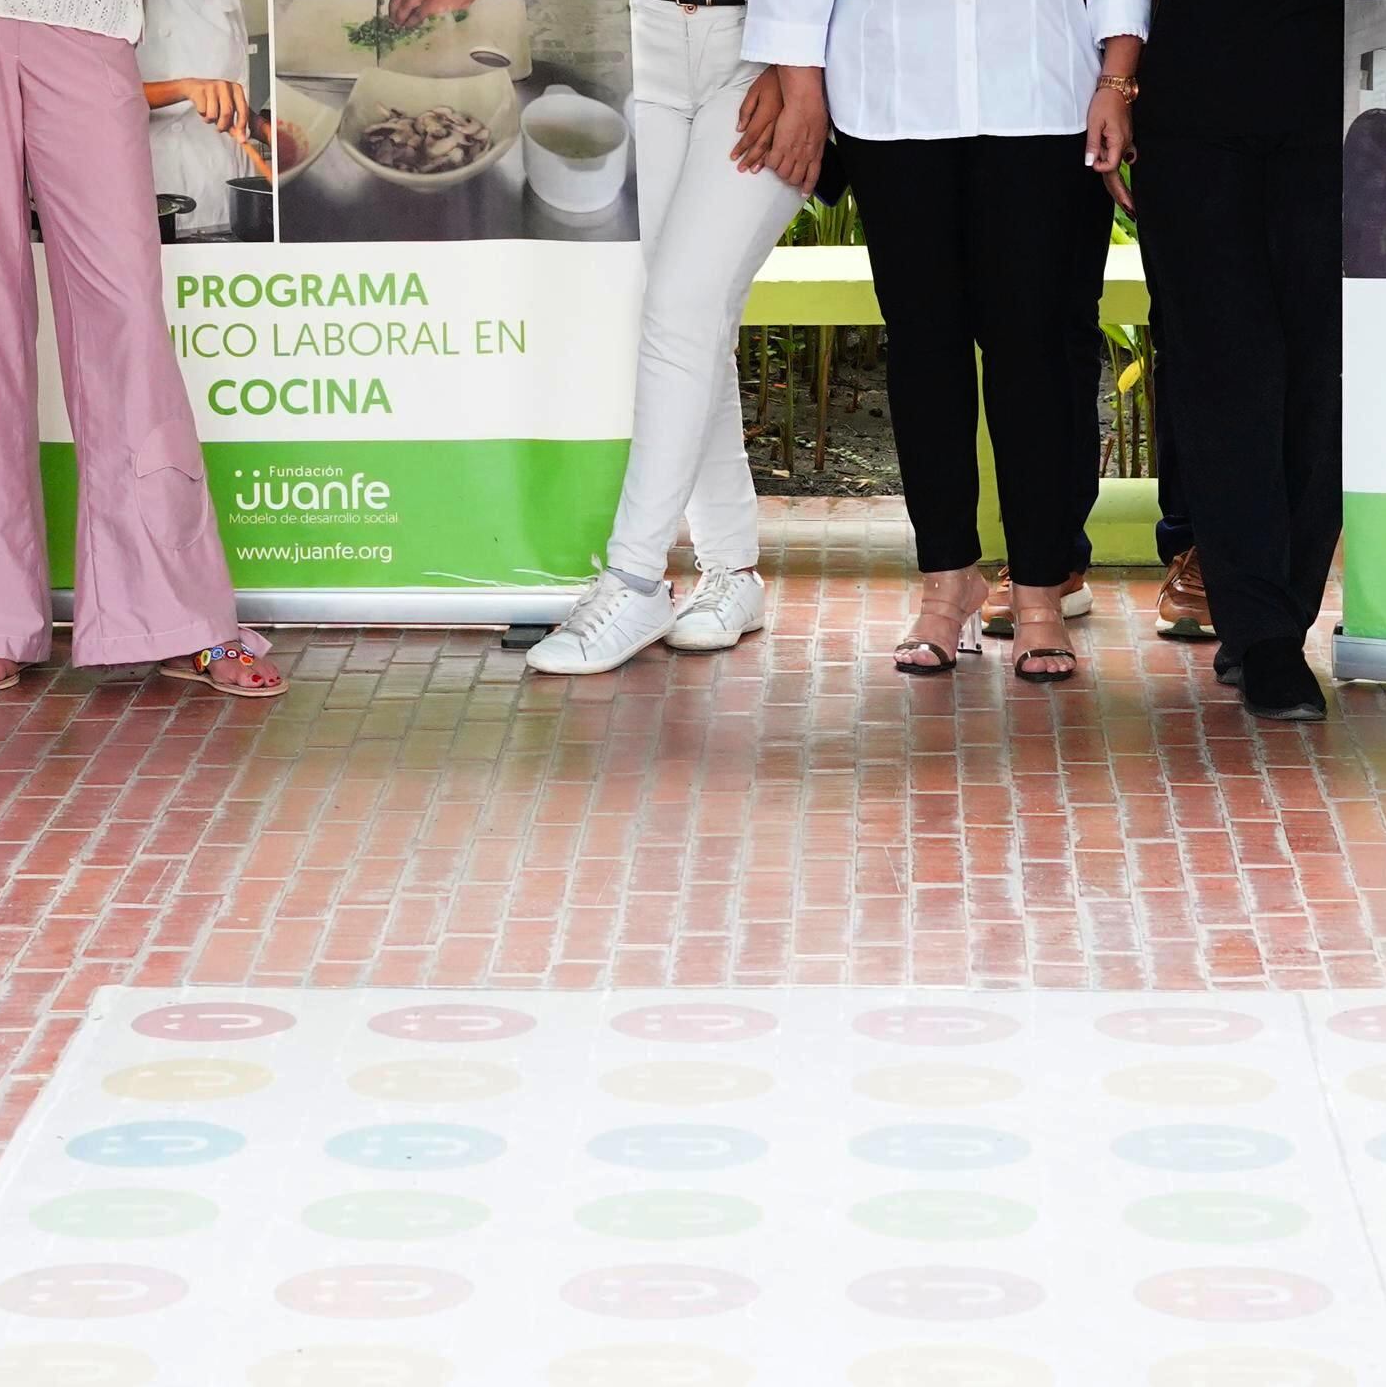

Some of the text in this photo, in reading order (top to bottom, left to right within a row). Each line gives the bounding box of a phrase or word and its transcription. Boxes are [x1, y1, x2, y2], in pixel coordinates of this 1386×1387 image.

[177, 273, 429, 309] PROGRAMA
[273, 321, 460, 357] LABORAL
[476, 320, 526, 354] EN
[208, 378, 393, 416] COCINA
[269, 465, 344, 478] Fundación
[235, 470, 390, 511] juanfe
[229, 511, 398, 524] Modelo de desarrollo social
[236, 542, 393, 563] www.juanfe.org
